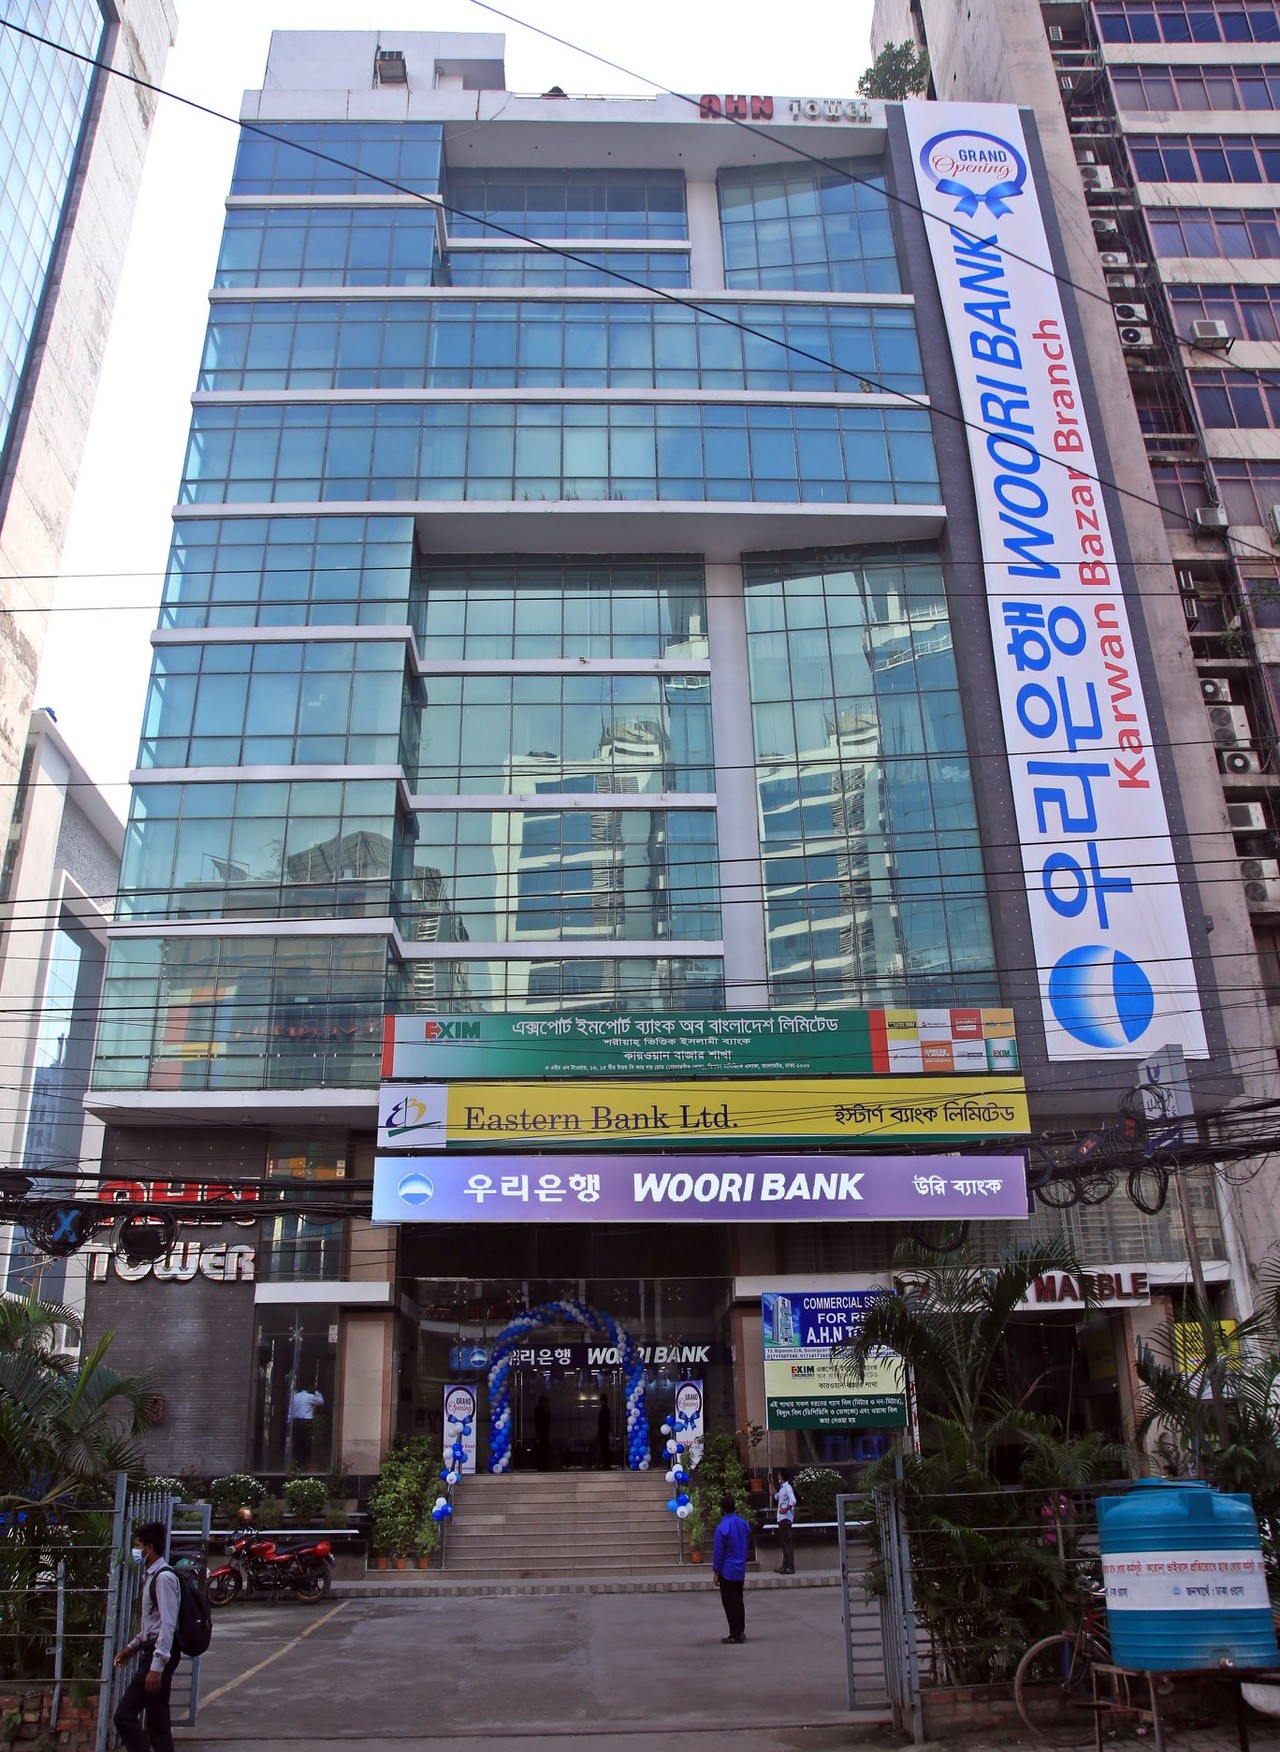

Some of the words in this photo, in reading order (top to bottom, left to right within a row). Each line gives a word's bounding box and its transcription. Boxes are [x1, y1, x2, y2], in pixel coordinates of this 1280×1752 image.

[700, 94, 774, 120] AHN
[789, 99, 873, 124] TOWER
[932, 155, 1013, 179] Opening
[958, 149, 1007, 162] GRAND
[950, 223, 1023, 371] BANK
[1032, 319, 1084, 453] Branch
[976, 374, 1061, 580] WOORI
[1068, 465, 1111, 586] Bazar
[1094, 603, 1150, 789] Karwan
[1002, 602, 1133, 930] 우리은행
[425, 1021, 481, 1039] EXIM
[512, 1017, 573, 1036] এক্সপোর্ট
[576, 1016, 631, 1035] ইমপোর্ট
[635, 1018, 676, 1034] ব্যাংক
[679, 1020, 705, 1034] অব
[708, 1017, 774, 1034] বাংলাদেশ
[778, 1015, 839, 1033] লিমিটেড
[679, 1036, 718, 1046] ইসলামী
[464, 1106, 580, 1132] Eastern
[590, 1104, 669, 1131] Bank
[679, 1103, 738, 1129] Ltd.
[890, 1107, 938, 1125] ব্যাংক
[942, 1100, 1015, 1122] লিমিটেড
[463, 1173, 601, 1204] 우리은행
[634, 1173, 755, 1203] WOORI
[761, 1173, 865, 1201] BANK
[911, 1175, 947, 1197] উরি
[950, 1177, 1003, 1197] ব্যাংক
[1034, 1272, 1149, 1303] MABLE
[803, 1296, 862, 1310] COMMERCIAL
[818, 1312, 847, 1324] FOR
[806, 1326, 842, 1344] A.H.N
[653, 1344, 712, 1365] BANK
[791, 1365, 814, 1374] EXIM
